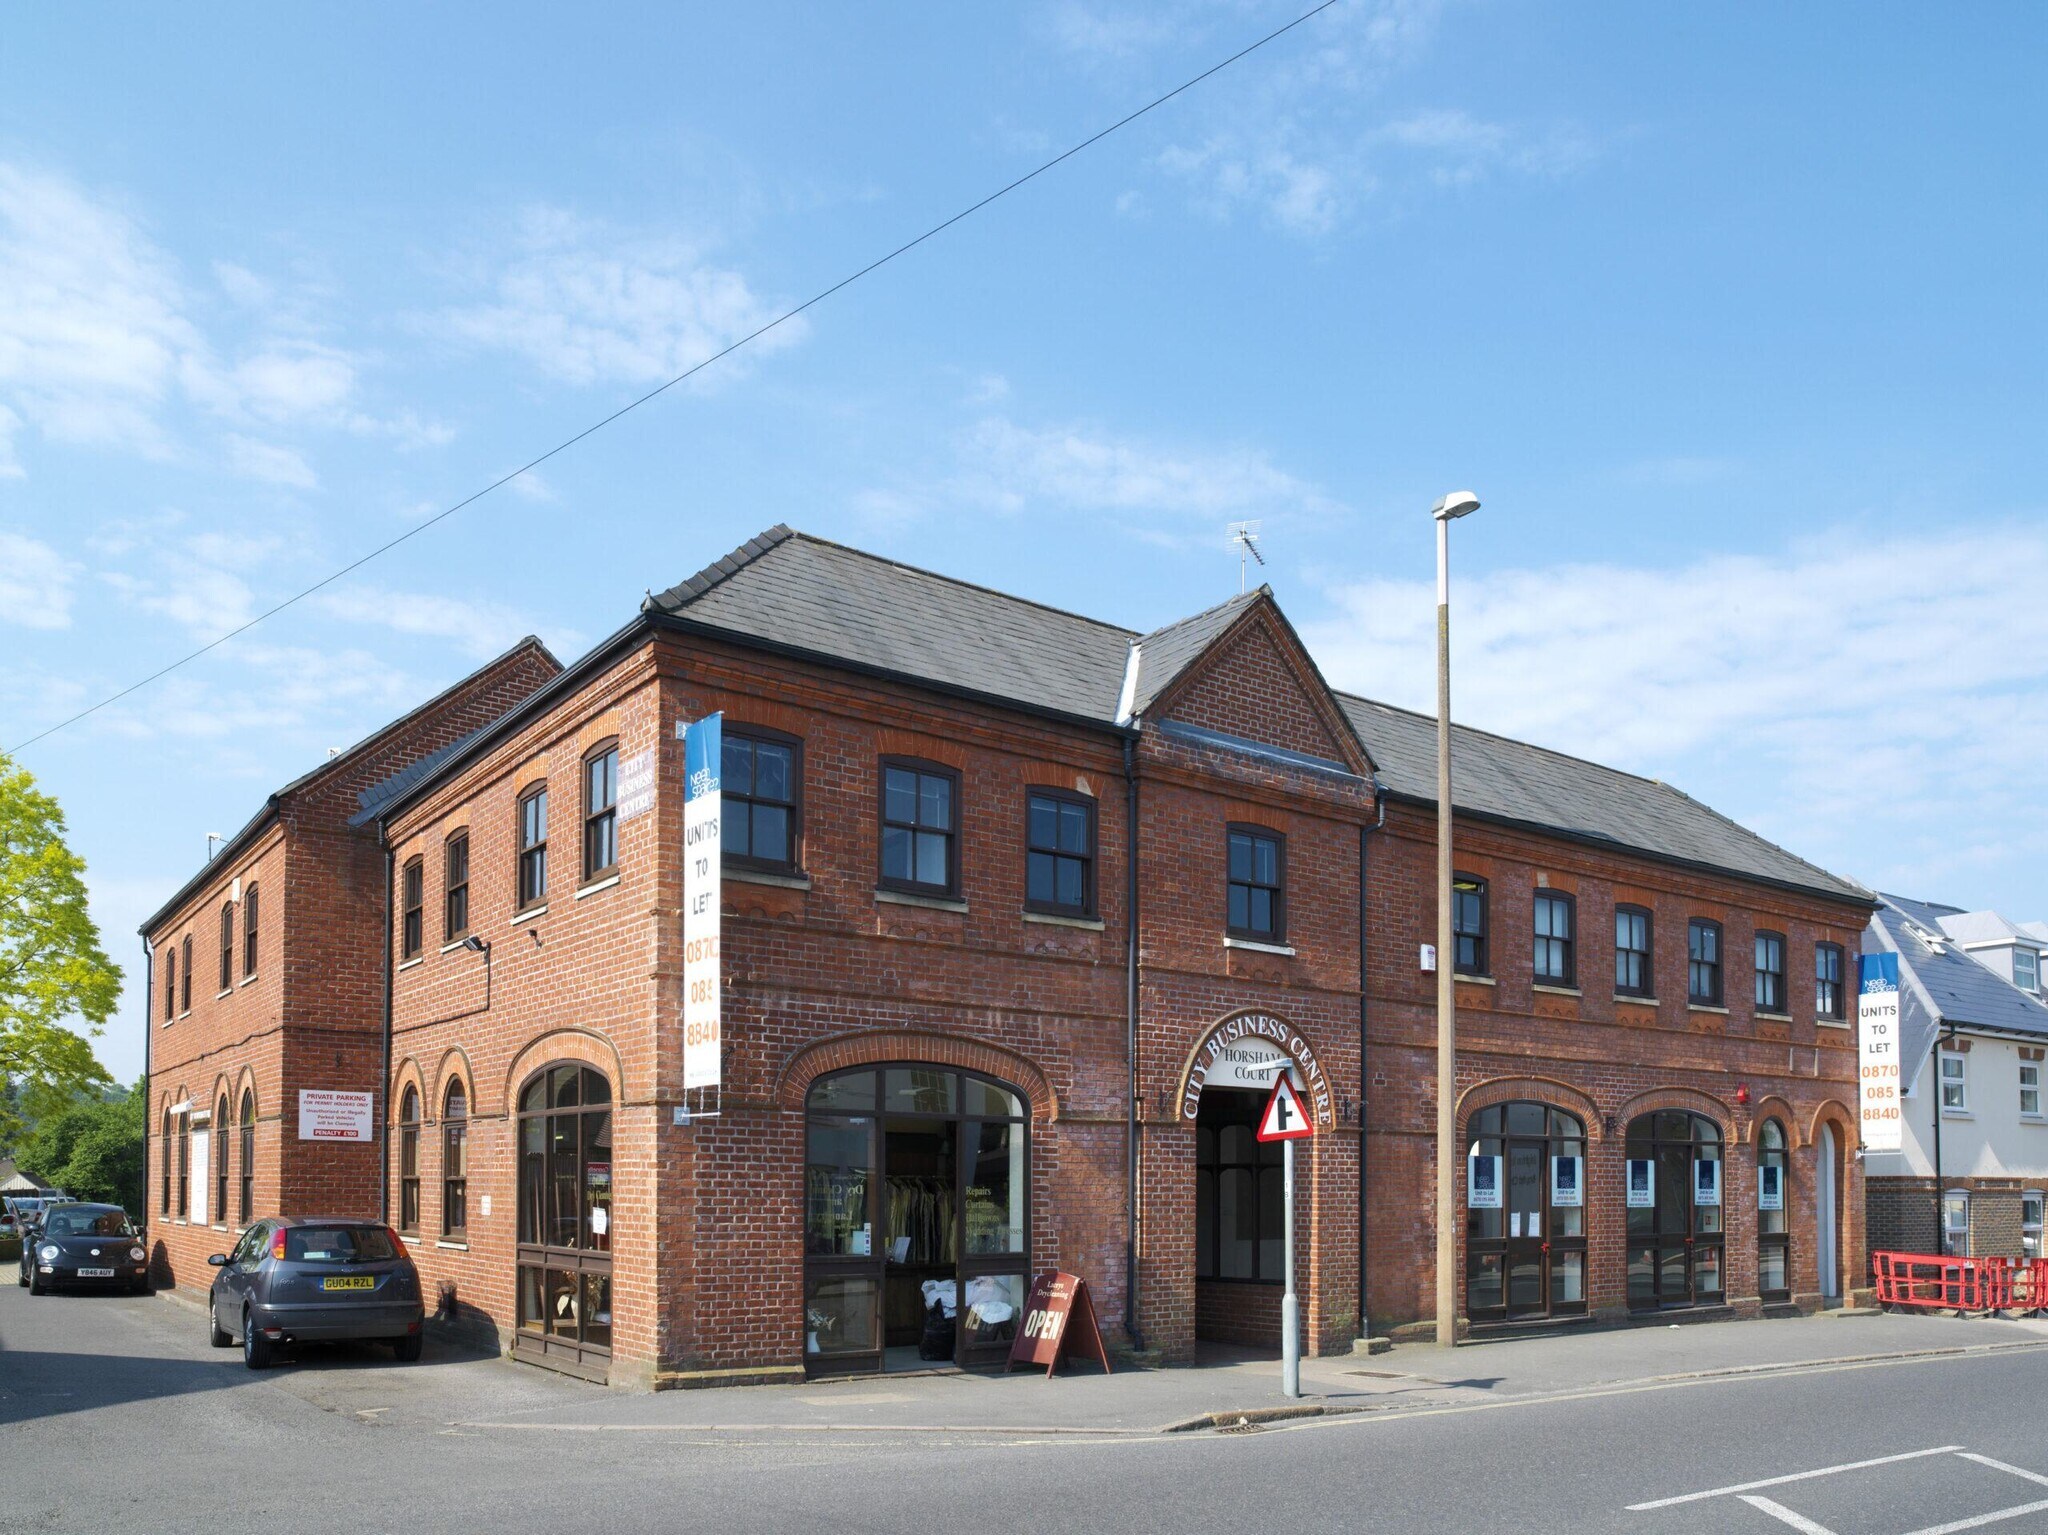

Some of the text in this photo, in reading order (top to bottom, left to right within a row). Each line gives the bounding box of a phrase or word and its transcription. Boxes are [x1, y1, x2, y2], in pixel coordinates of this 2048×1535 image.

[617, 768, 653, 800] BUSINESS
[620, 791, 652, 819] CENTRE
[687, 818, 718, 847] UNITS
[695, 857, 708, 879] TO
[693, 892, 713, 915] LET
[1861, 1005, 1897, 1018] UNITS
[687, 1020, 719, 1046] 8840
[1872, 1024, 1887, 1035] TO
[1869, 1043, 1891, 1054] LET
[1225, 1049, 1281, 1063] HORSHAM
[1184, 1015, 1331, 1125] CITY BUSINESS CENTRE
[1235, 1066, 1271, 1081] COURT
[1861, 1065, 1899, 1078] 0870
[1867, 1087, 1894, 1099] 085
[1863, 1107, 1899, 1120] 8840
[966, 1186, 991, 1197] Repairs
[326, 1278, 372, 1288] GU04 RZL
[1024, 1309, 1064, 1340] OPEN
